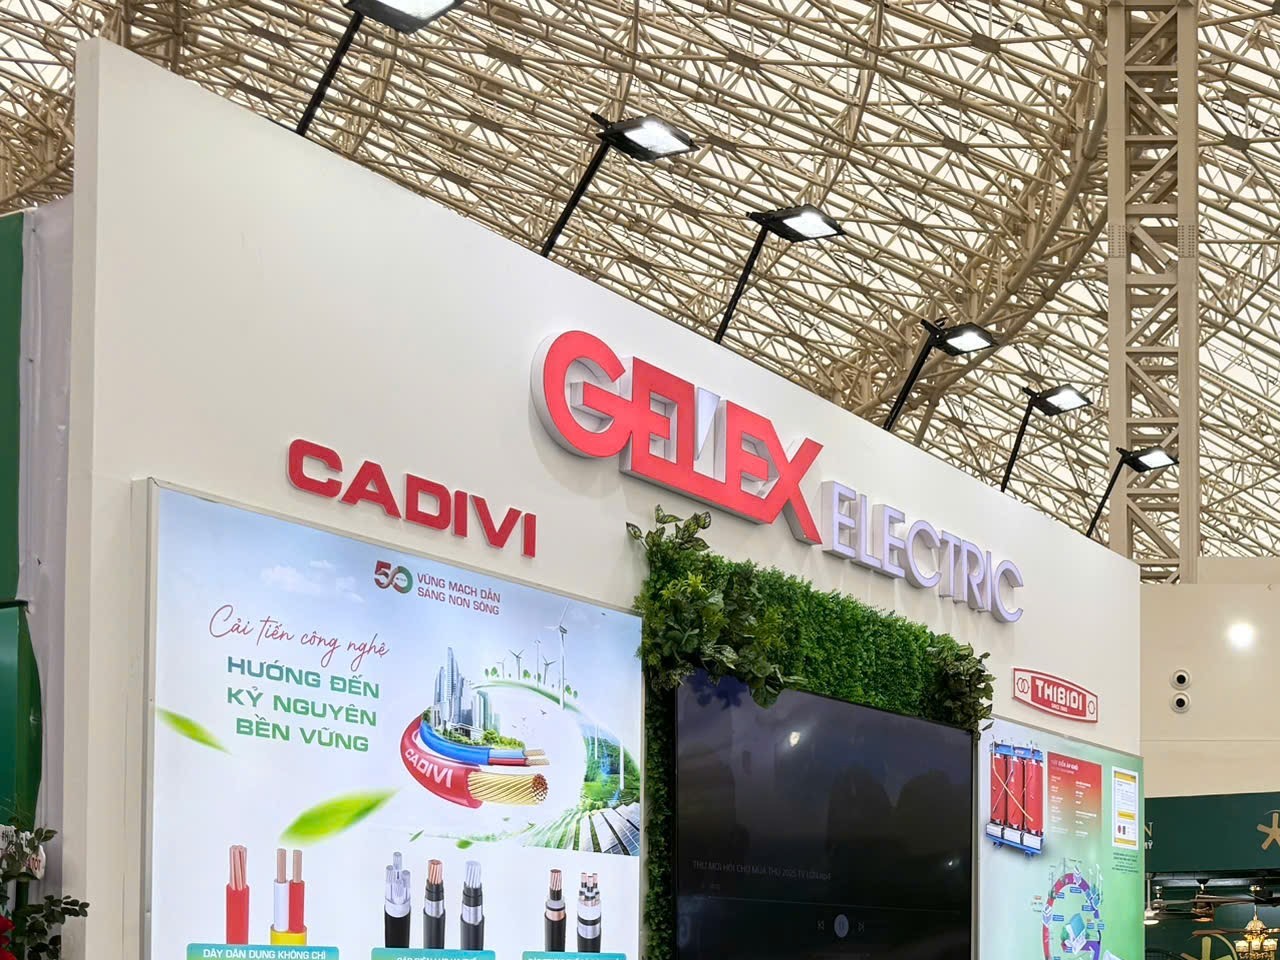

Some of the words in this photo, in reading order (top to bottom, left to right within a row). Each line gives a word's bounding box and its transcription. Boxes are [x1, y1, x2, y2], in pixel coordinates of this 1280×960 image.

[540, 330, 823, 546] GELEX
[821, 480, 1023, 624] ELECTRIC
[287, 438, 537, 558] CADIVI
[374, 560, 414, 594] 50
[448, 594, 470, 609] NON
[209, 604, 254, 638] Cải
[300, 630, 342, 668] công
[347, 633, 390, 672] nghệ
[227, 656, 321, 688] HƯỚNG
[330, 674, 380, 699] ĐẾN
[1035, 678, 1083, 711] THIBIDI
[227, 686, 264, 708] KỶ
[273, 695, 377, 727] NGUYÊN
[236, 714, 290, 741] BỀN
[300, 727, 369, 752] VỮNG
[404, 748, 454, 789] CADIVI
